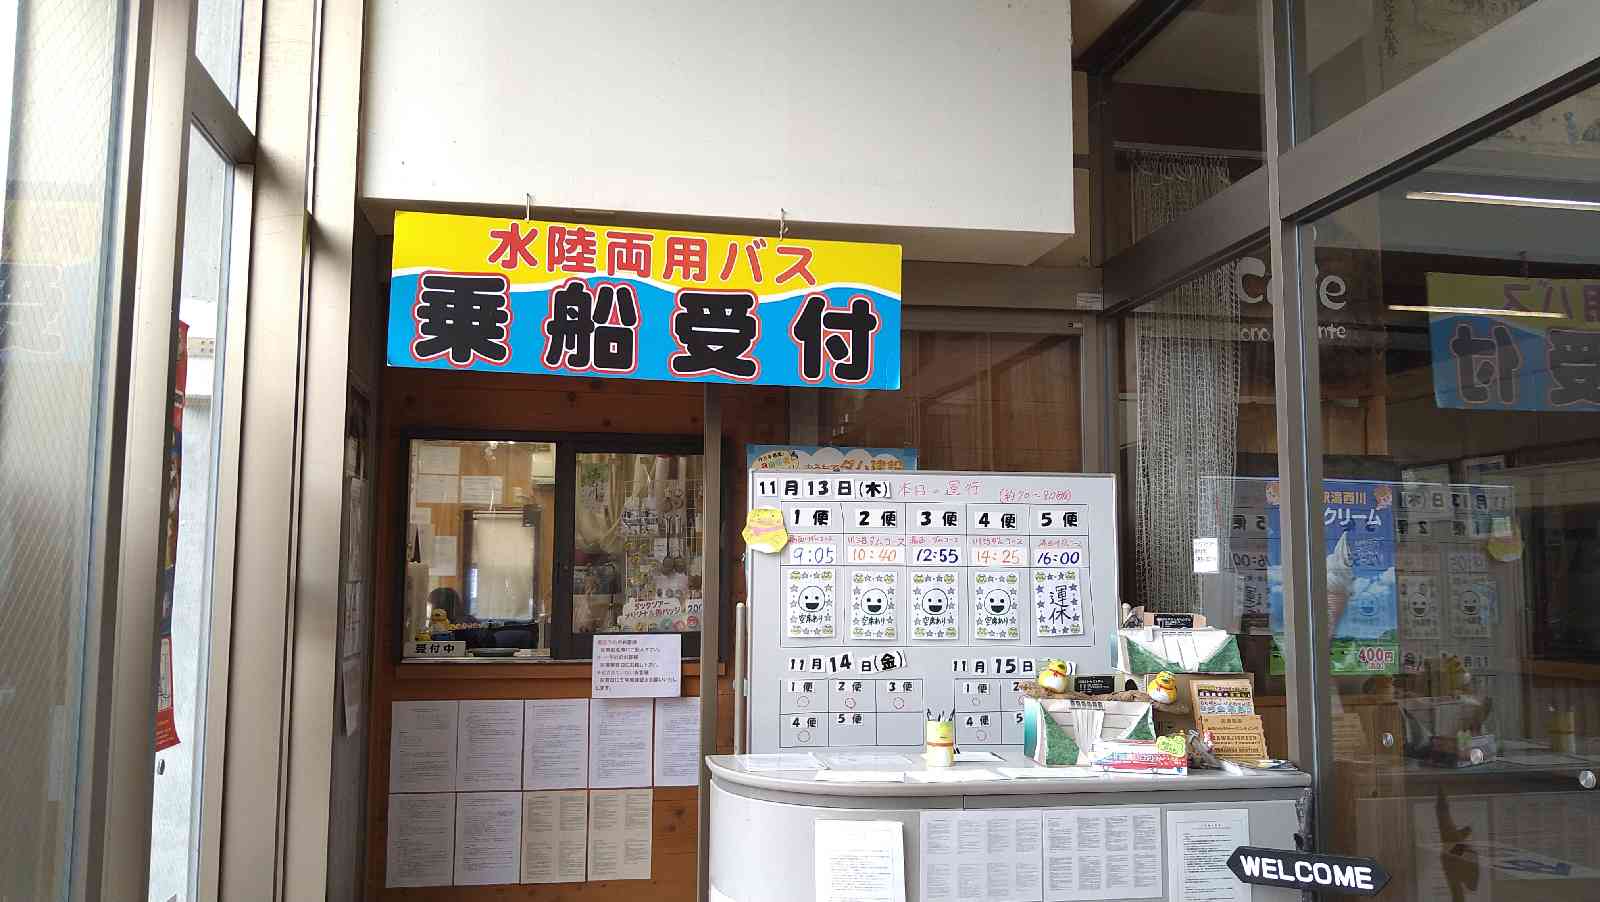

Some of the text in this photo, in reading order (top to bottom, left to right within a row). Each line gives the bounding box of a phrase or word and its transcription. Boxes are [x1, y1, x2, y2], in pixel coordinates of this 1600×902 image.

[487, 222, 816, 286] 水陸両用バス
[413, 270, 881, 384] 乗船受付
[759, 480, 888, 497] 11月13日(木)
[794, 509, 1078, 529] 1便 2便 3便 4便 5便
[1324, 507, 1381, 527] クリーム
[793, 547, 1080, 565] 9:05 10:40 12:55 14:25 16:00
[1048, 585, 1072, 625] 運休
[416, 643, 455, 654] 受付中
[790, 650, 904, 673] 11月14日(金)
[1239, 855, 1374, 890] WELCOME
